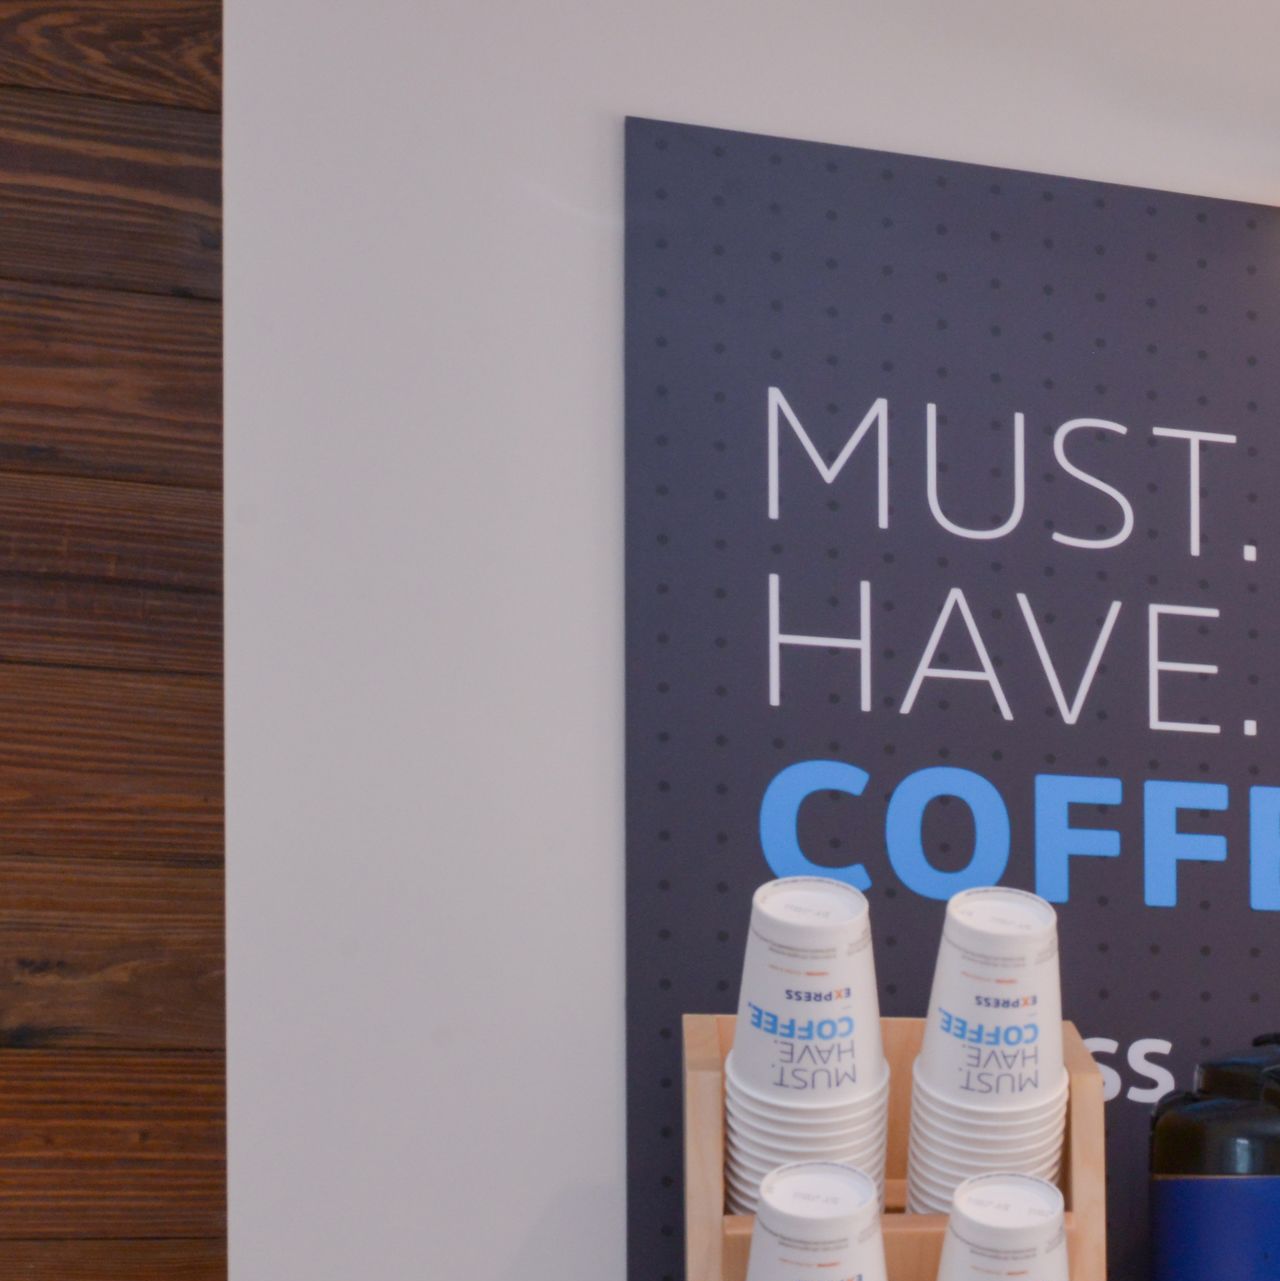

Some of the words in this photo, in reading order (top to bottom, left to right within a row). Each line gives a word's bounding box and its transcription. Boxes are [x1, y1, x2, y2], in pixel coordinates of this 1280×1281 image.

[768, 386, 1257, 562] MUST.
[768, 573, 1257, 736] HAVE.
[785, 987, 851, 1002] EXPRESS
[975, 995, 1038, 1008] EXPRESS
[748, 1001, 855, 1041] COFFEE.
[938, 1007, 1040, 1046] COFFEE.
[774, 1039, 855, 1065] HAVE.
[962, 1043, 1038, 1070] HAVE.
[772, 1062, 856, 1090] MUST.
[959, 1067, 1039, 1094] MUST.
